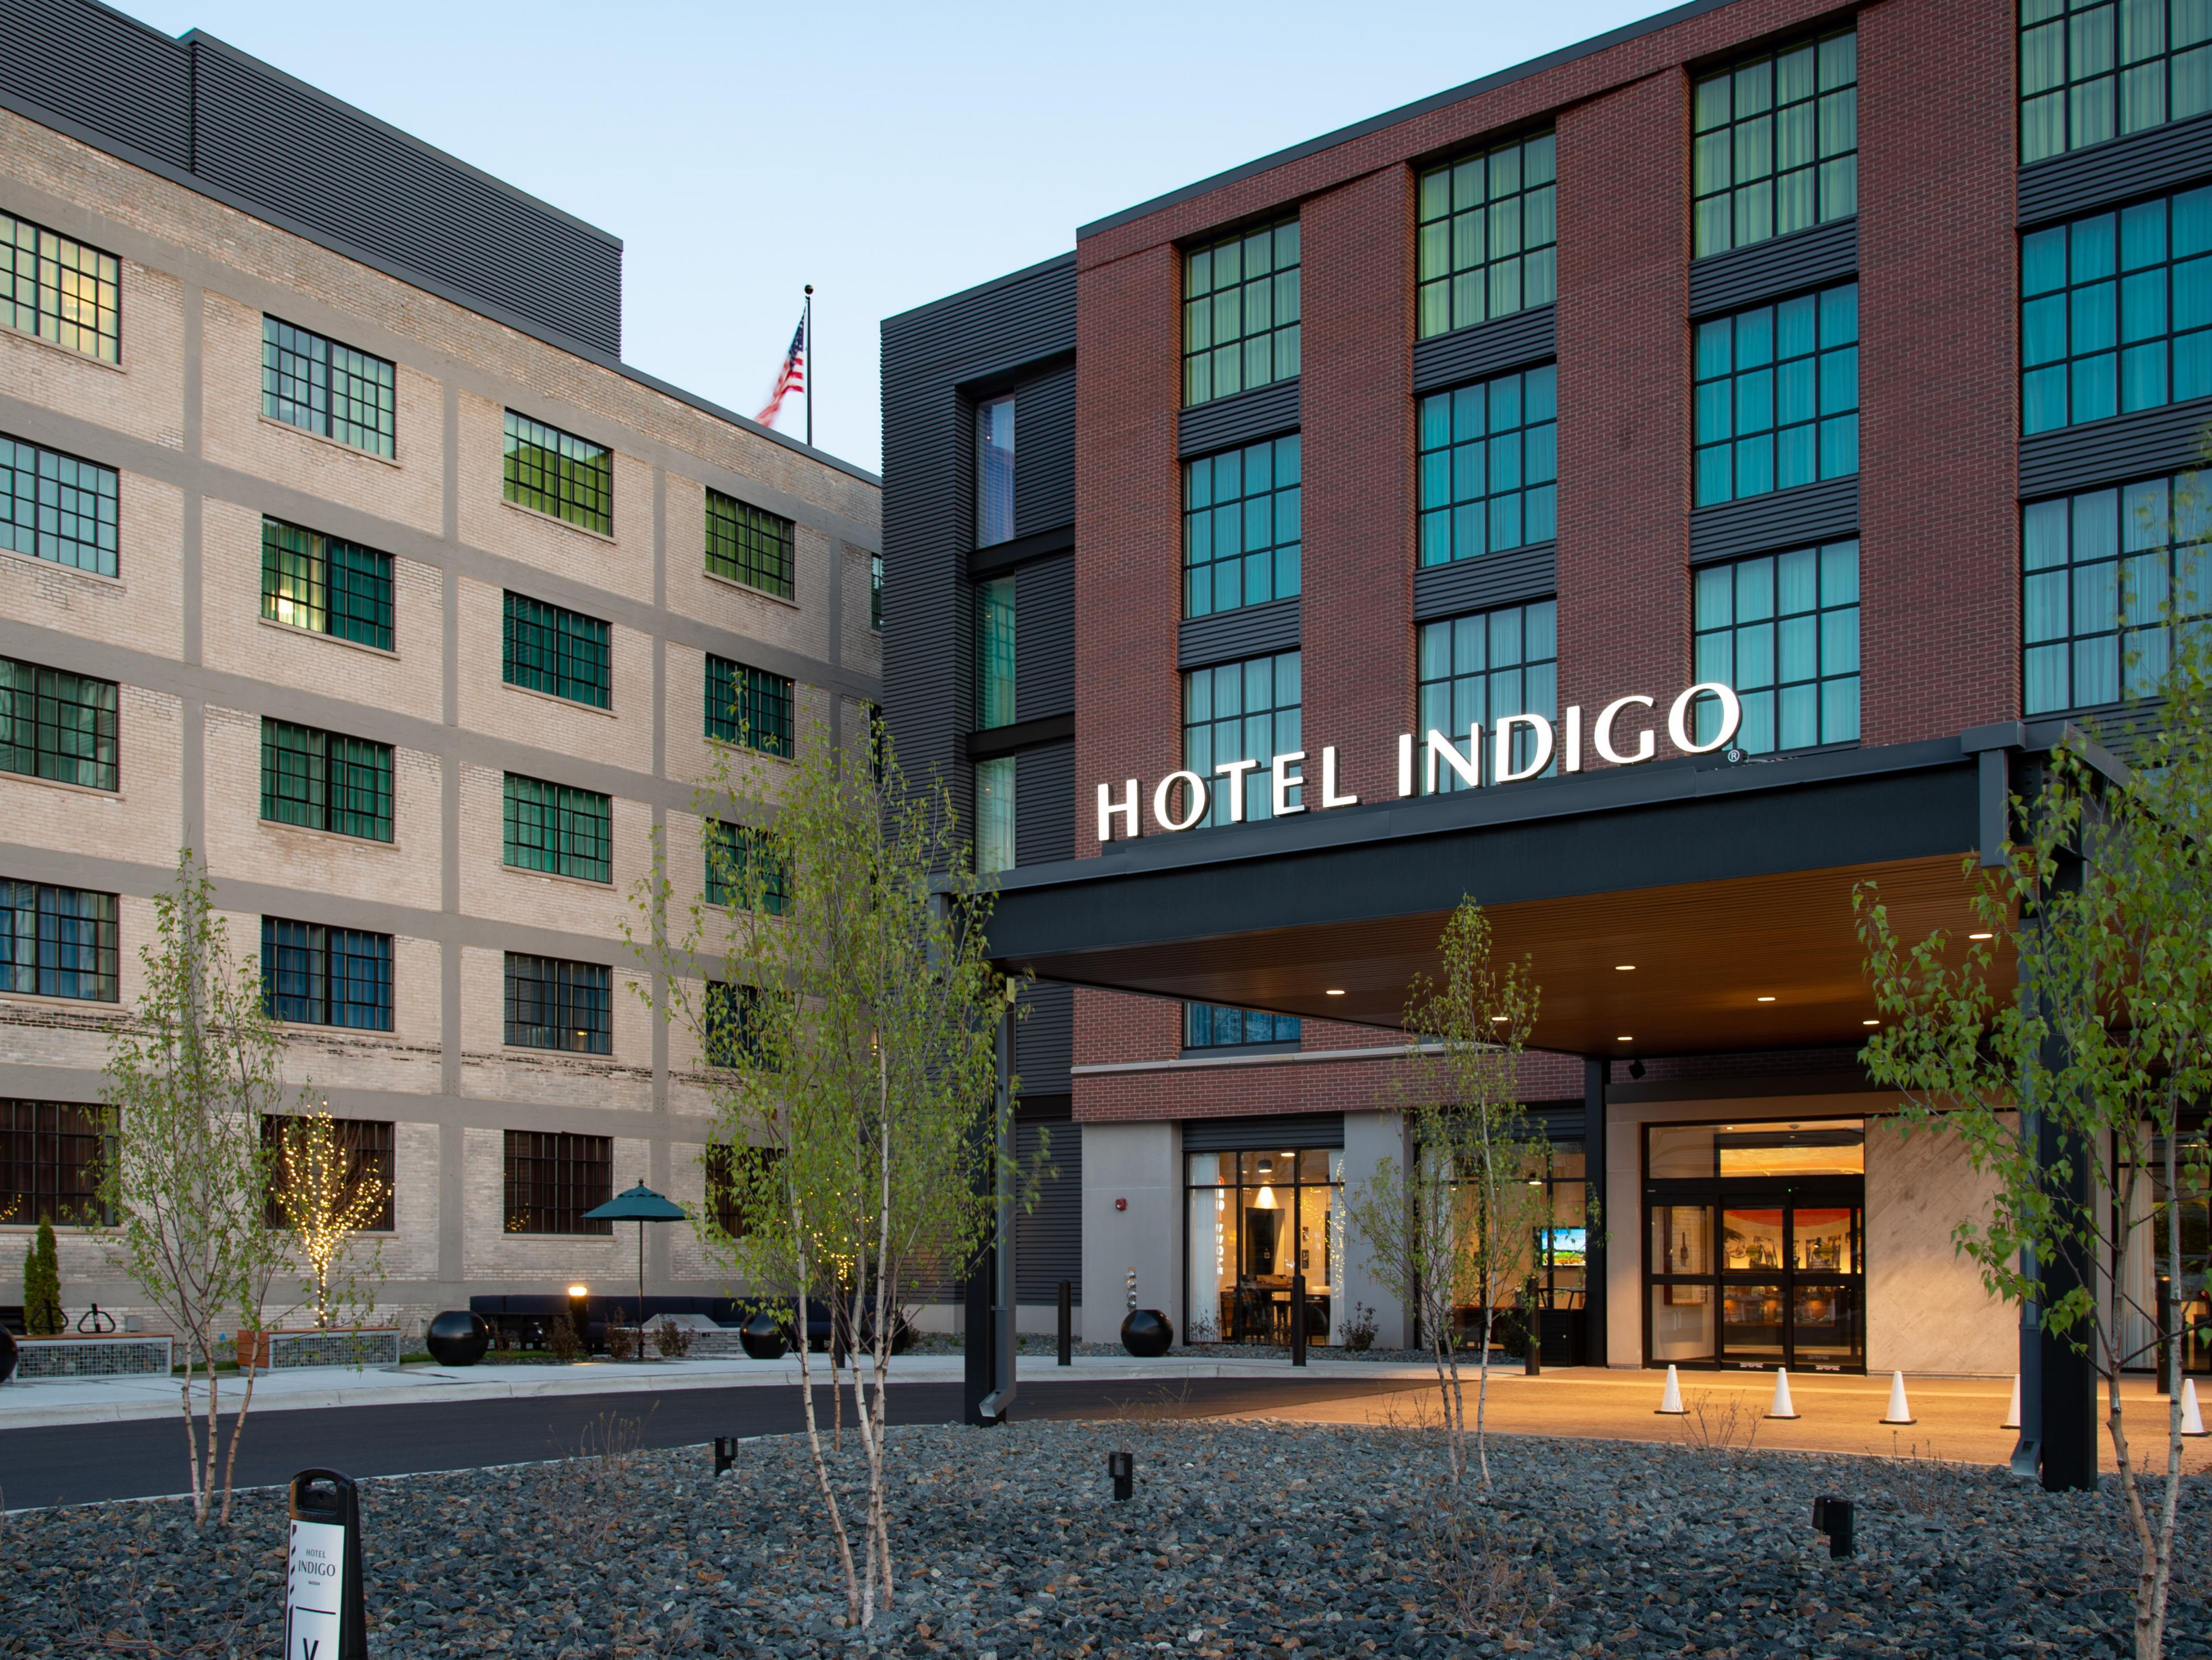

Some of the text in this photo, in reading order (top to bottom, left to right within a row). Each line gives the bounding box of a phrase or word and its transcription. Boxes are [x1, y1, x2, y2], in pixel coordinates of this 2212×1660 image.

[1098, 746, 1361, 842] HOTEL
[306, 1548, 326, 1559] HOTEL
[298, 1559, 336, 1576] INDIGO
